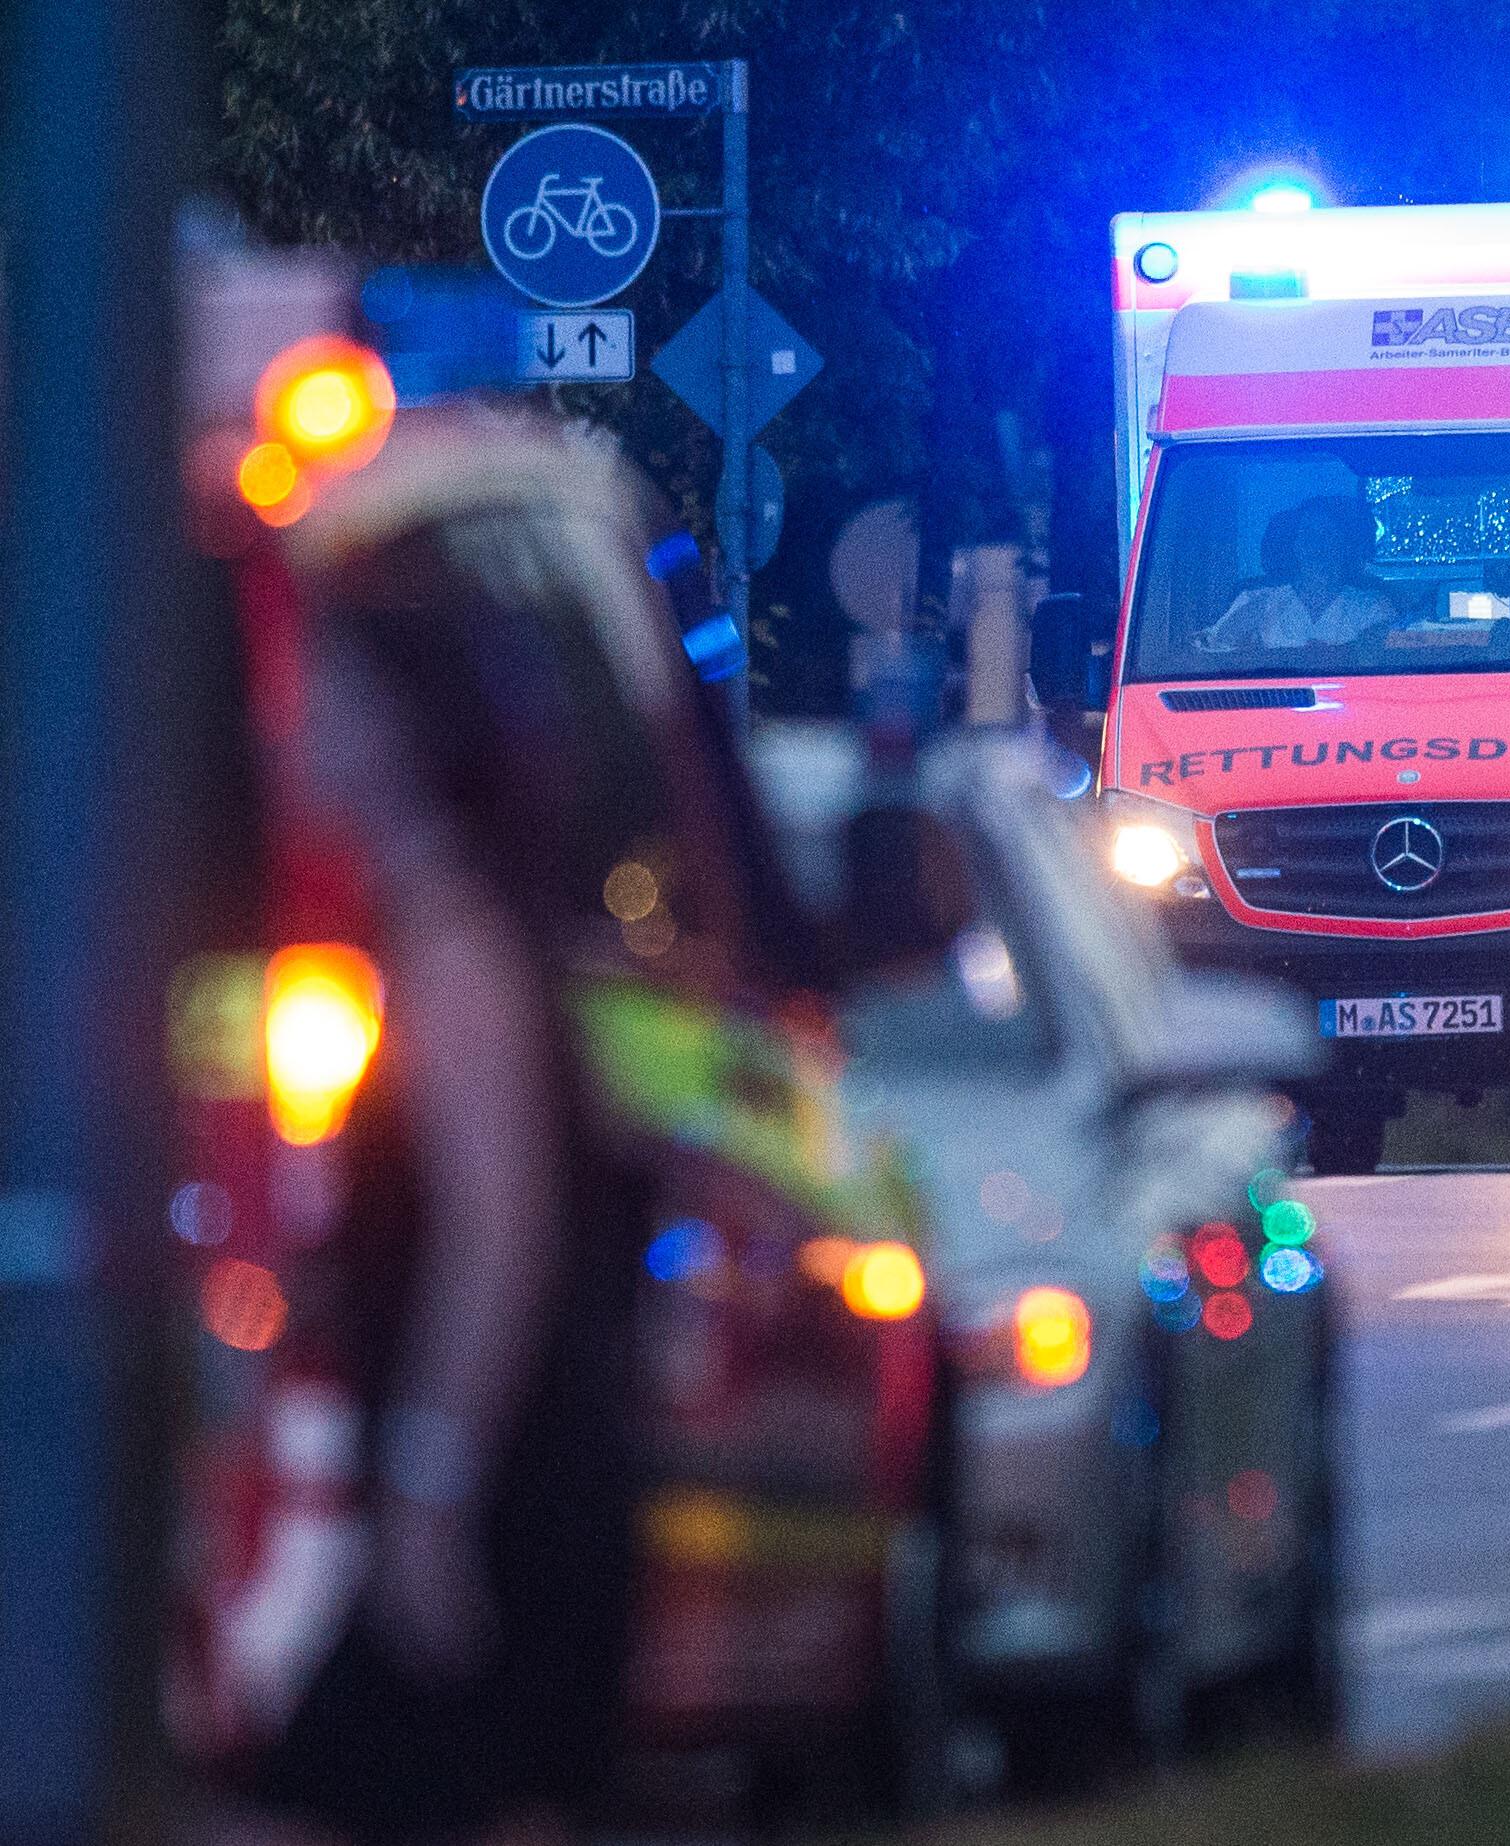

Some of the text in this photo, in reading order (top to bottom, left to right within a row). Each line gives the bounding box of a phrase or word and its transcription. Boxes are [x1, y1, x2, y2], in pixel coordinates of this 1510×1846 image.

[470, 69, 707, 111] Gärtnerstraße
[1338, 1003, 1358, 1032] M
[1423, 1000, 1497, 1030] 7251
